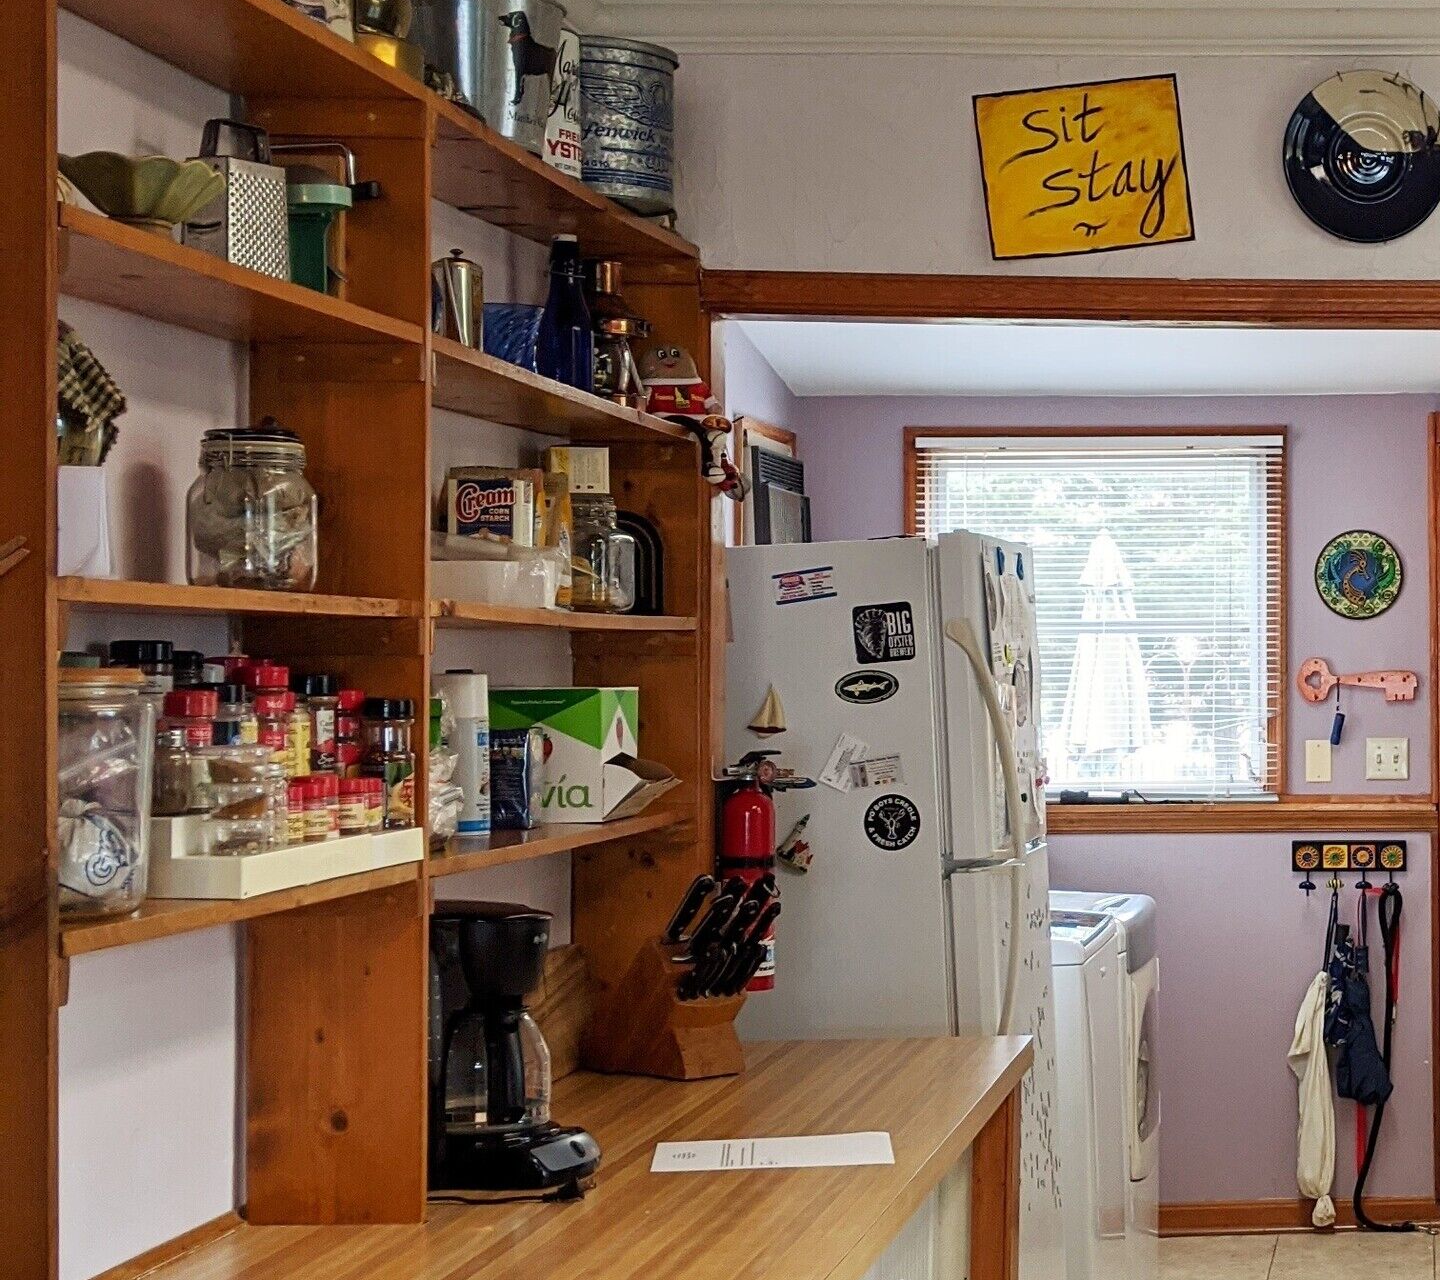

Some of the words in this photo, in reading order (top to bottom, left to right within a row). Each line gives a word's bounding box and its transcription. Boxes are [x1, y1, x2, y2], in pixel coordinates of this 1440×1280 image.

[559, 128, 581, 144] FRE
[455, 483, 516, 522] Cream
[480, 514, 510, 522] STARCH
[885, 610, 912, 636] BIG
[888, 635, 914, 648] OYSTER
[896, 826, 917, 846] CATCH
